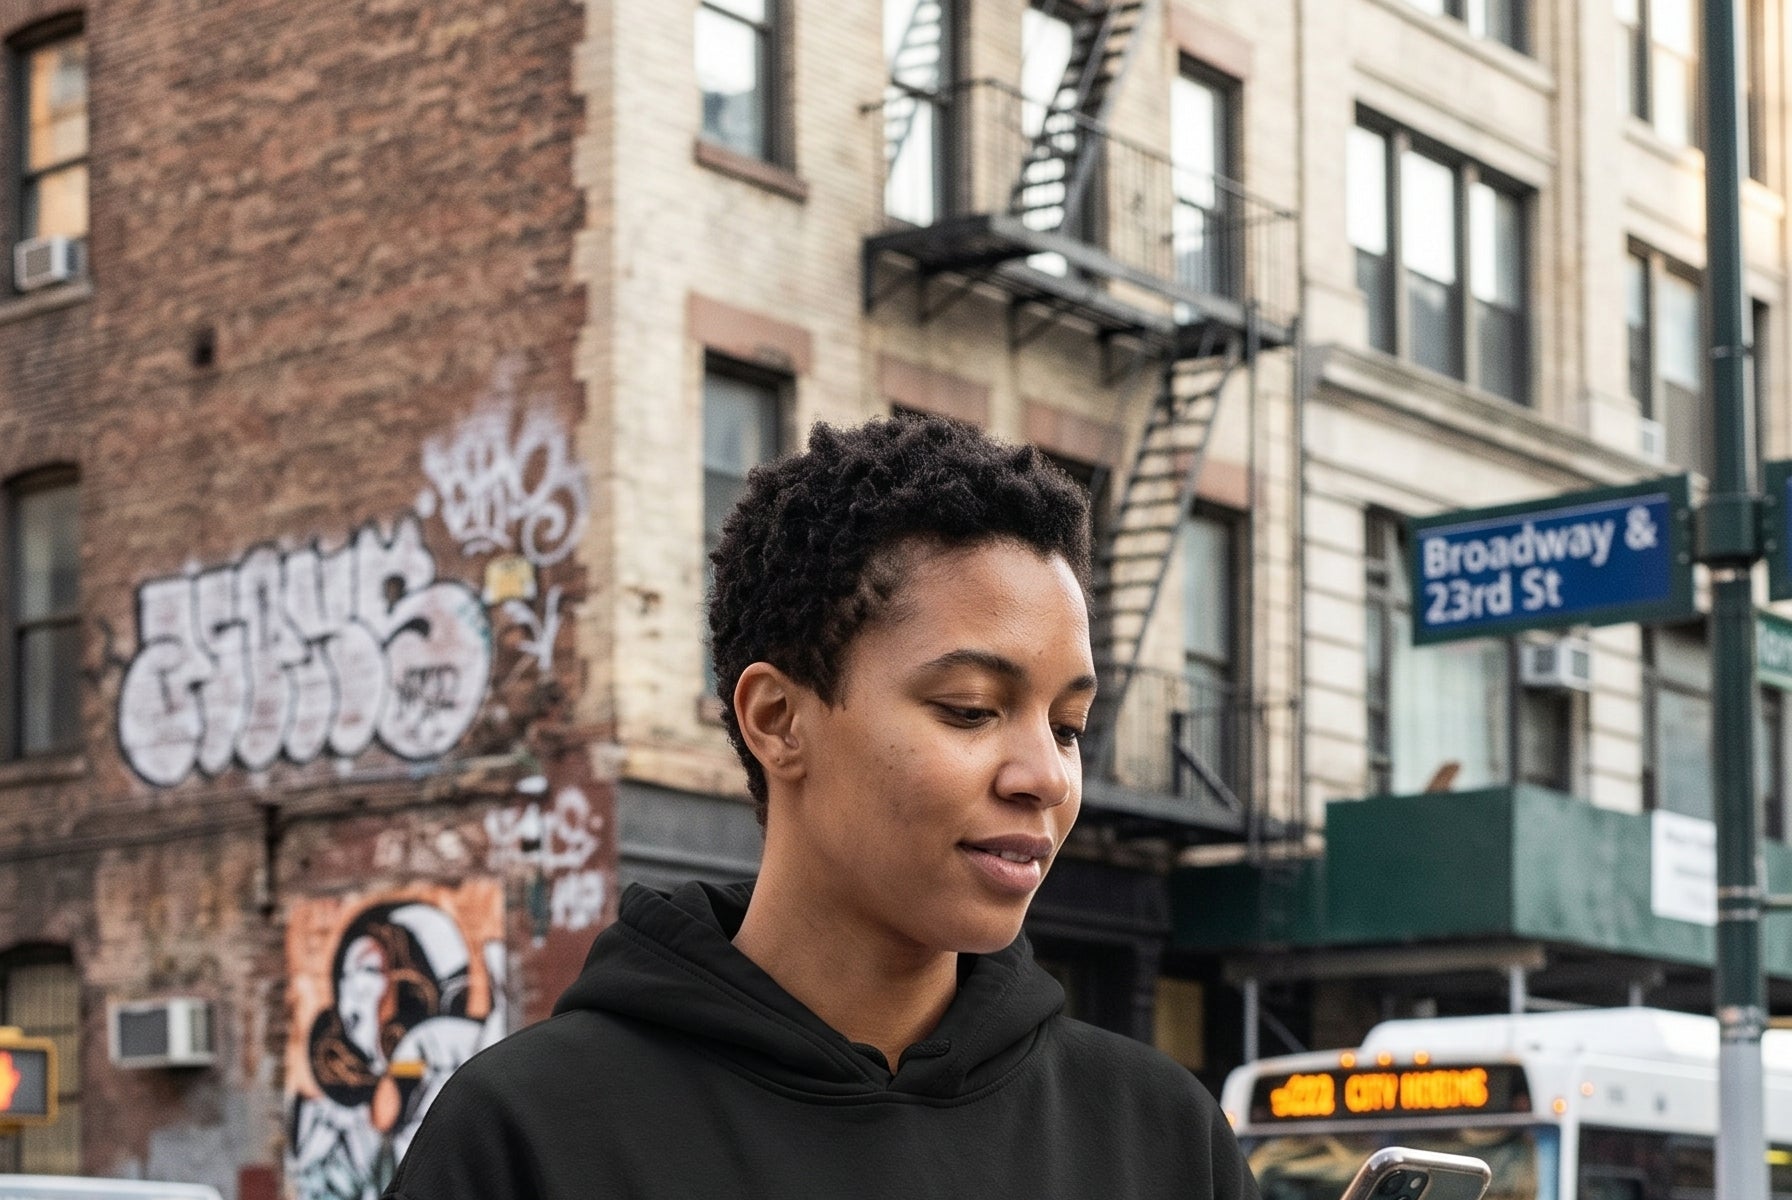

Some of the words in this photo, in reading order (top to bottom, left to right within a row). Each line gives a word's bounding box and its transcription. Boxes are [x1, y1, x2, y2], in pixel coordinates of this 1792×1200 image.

[1424, 521, 1614, 579] Broadway
[1625, 506, 1657, 551] &
[1426, 571, 1512, 624] 23rd
[1522, 568, 1561, 609] St
